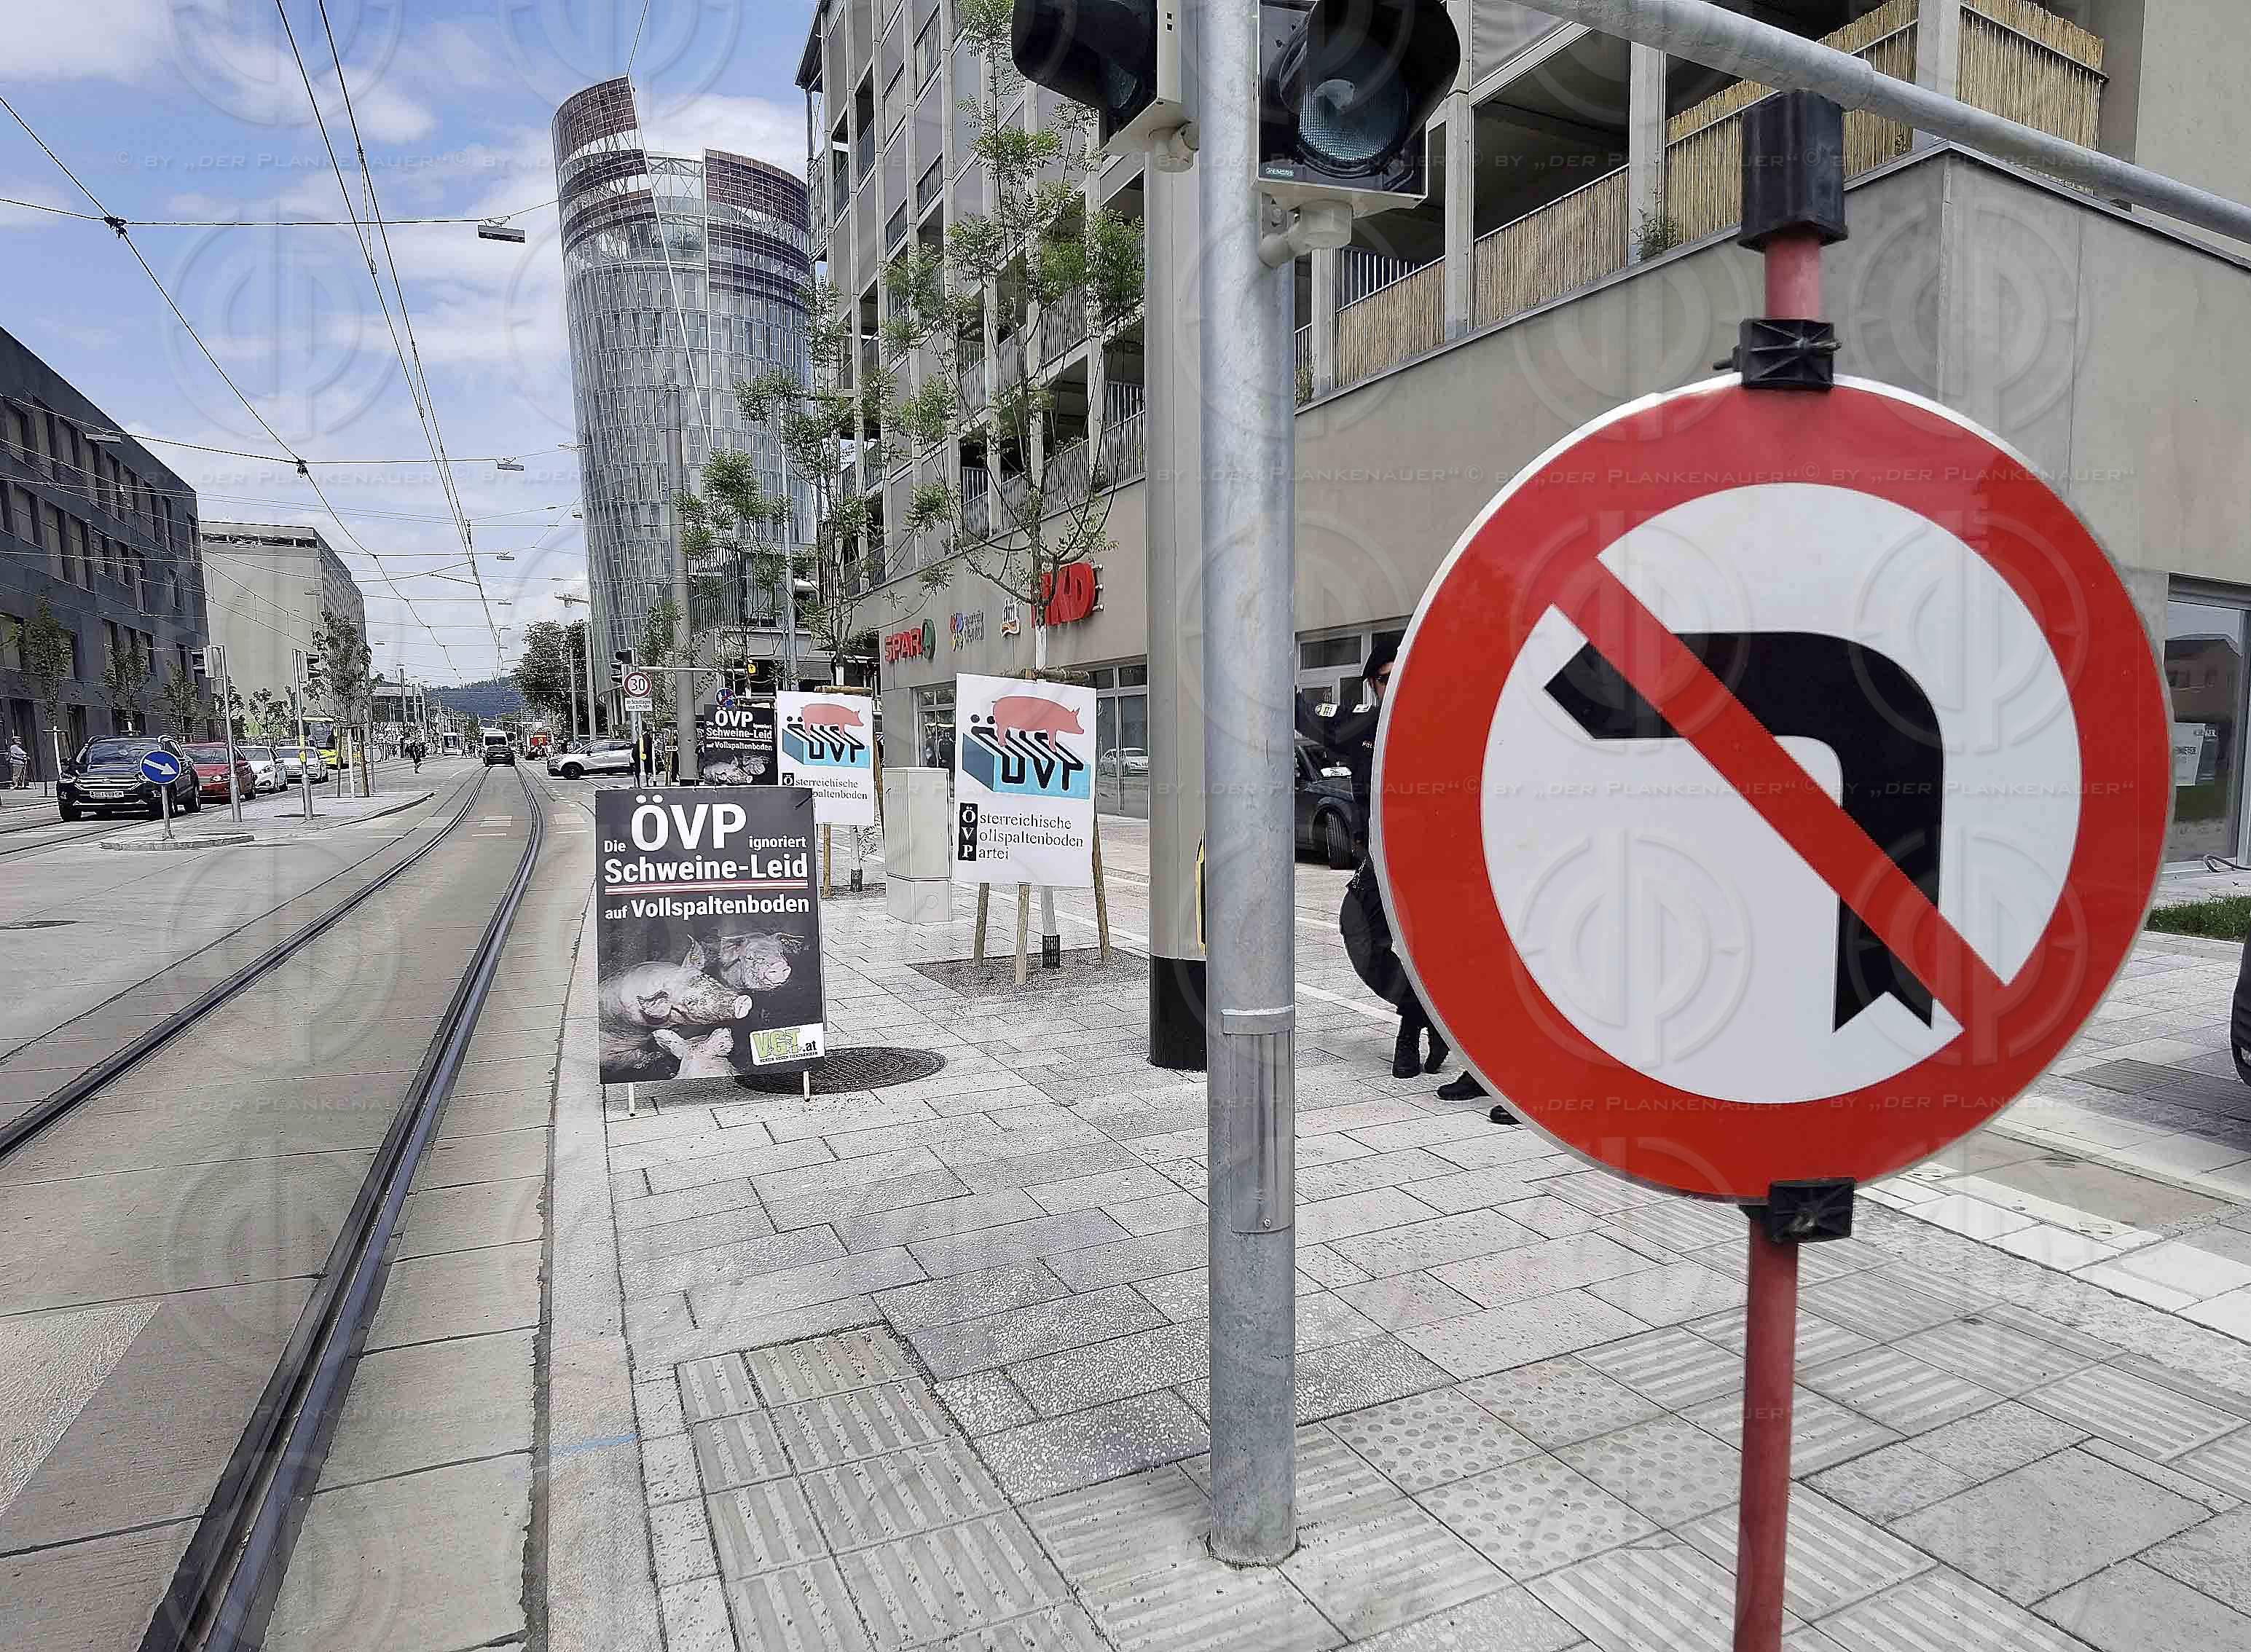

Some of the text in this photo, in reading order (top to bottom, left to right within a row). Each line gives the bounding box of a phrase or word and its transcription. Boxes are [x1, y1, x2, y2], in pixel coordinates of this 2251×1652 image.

[885, 629, 921, 661] SPAR
[631, 678, 645, 691] 30
[715, 707, 753, 728] ÖVP
[706, 727, 772, 739] Schweine-Leid
[714, 741, 773, 752] Vollspaltenboden
[783, 774, 859, 788] Österreichische
[812, 789, 868, 800] paltenboden
[604, 794, 806, 853] Die ÖVP ignoriert
[960, 805, 1072, 830] Österreichische
[961, 826, 1084, 848] Vollspaltenboden
[961, 844, 1010, 860] Partei
[604, 853, 808, 884] Schweine-Leid
[605, 894, 810, 921] auf Vollspaltenboden
